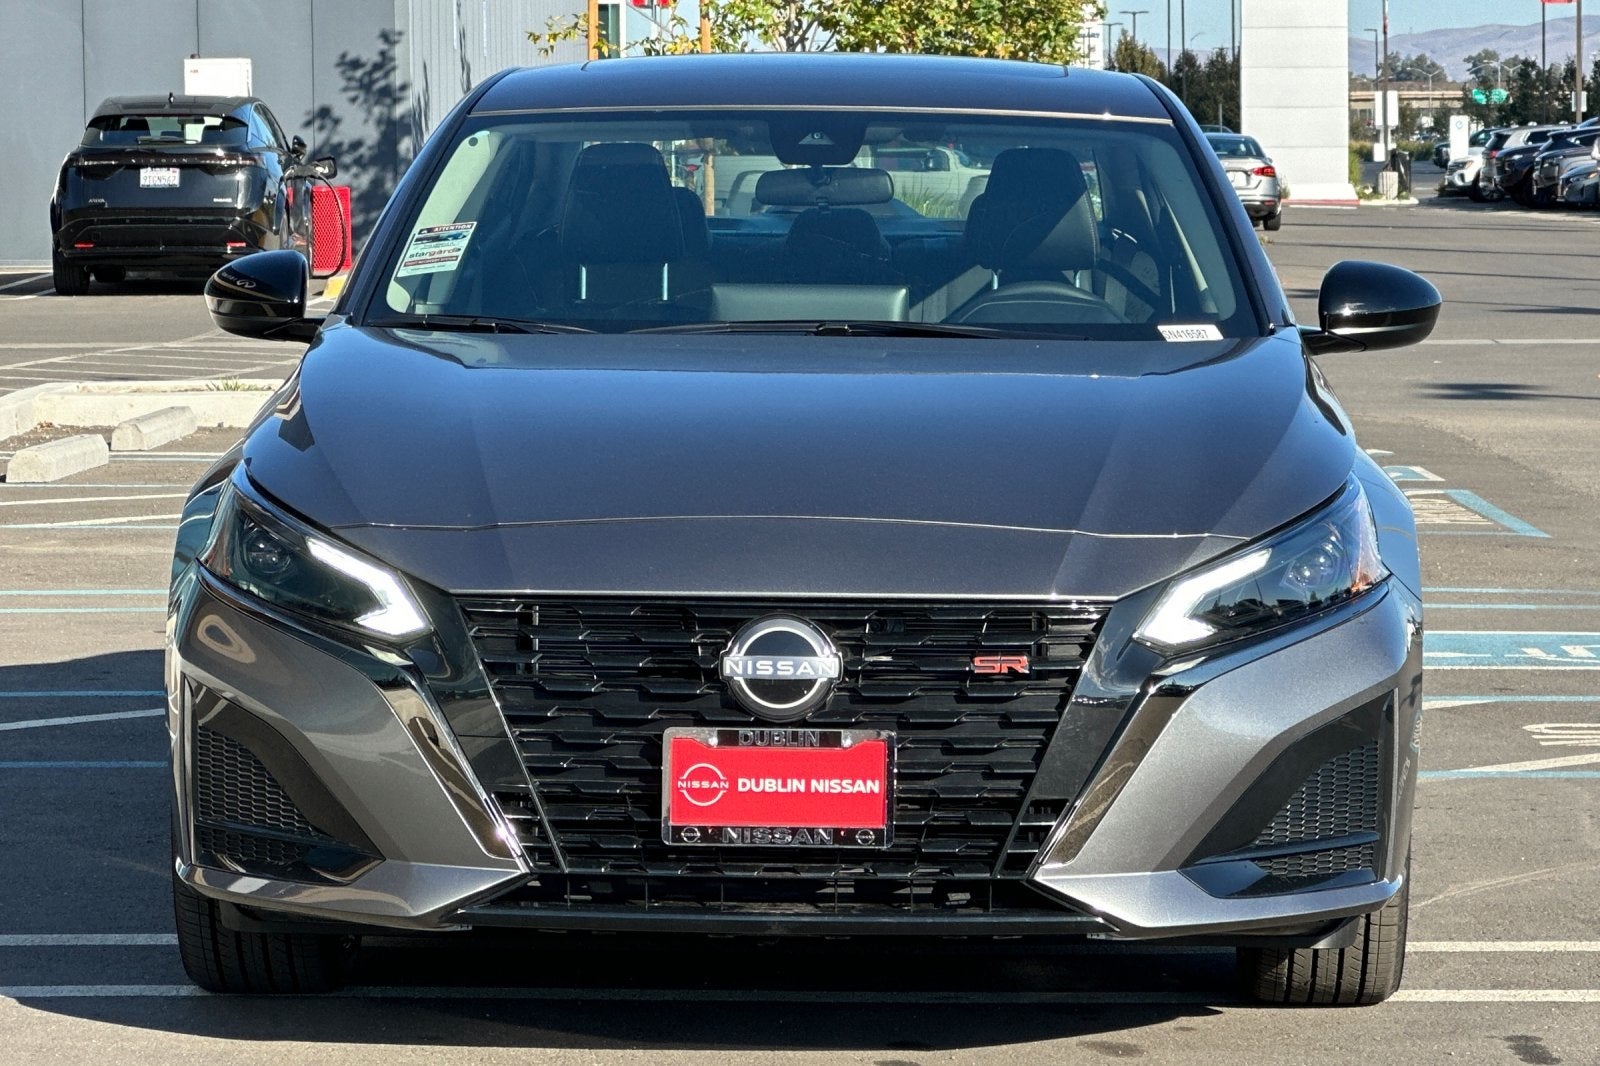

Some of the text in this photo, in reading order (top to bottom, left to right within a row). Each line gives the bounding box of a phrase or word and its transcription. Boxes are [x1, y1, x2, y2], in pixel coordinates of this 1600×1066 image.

[433, 224, 472, 232] ATTENTION
[725, 659, 836, 676] NISSAN
[973, 655, 1030, 673] SR
[738, 730, 820, 747] DUBLIN
[677, 780, 729, 789] NISSAN
[737, 778, 880, 794] DUBLIN NISSAN
[722, 827, 834, 845] NISSAN
